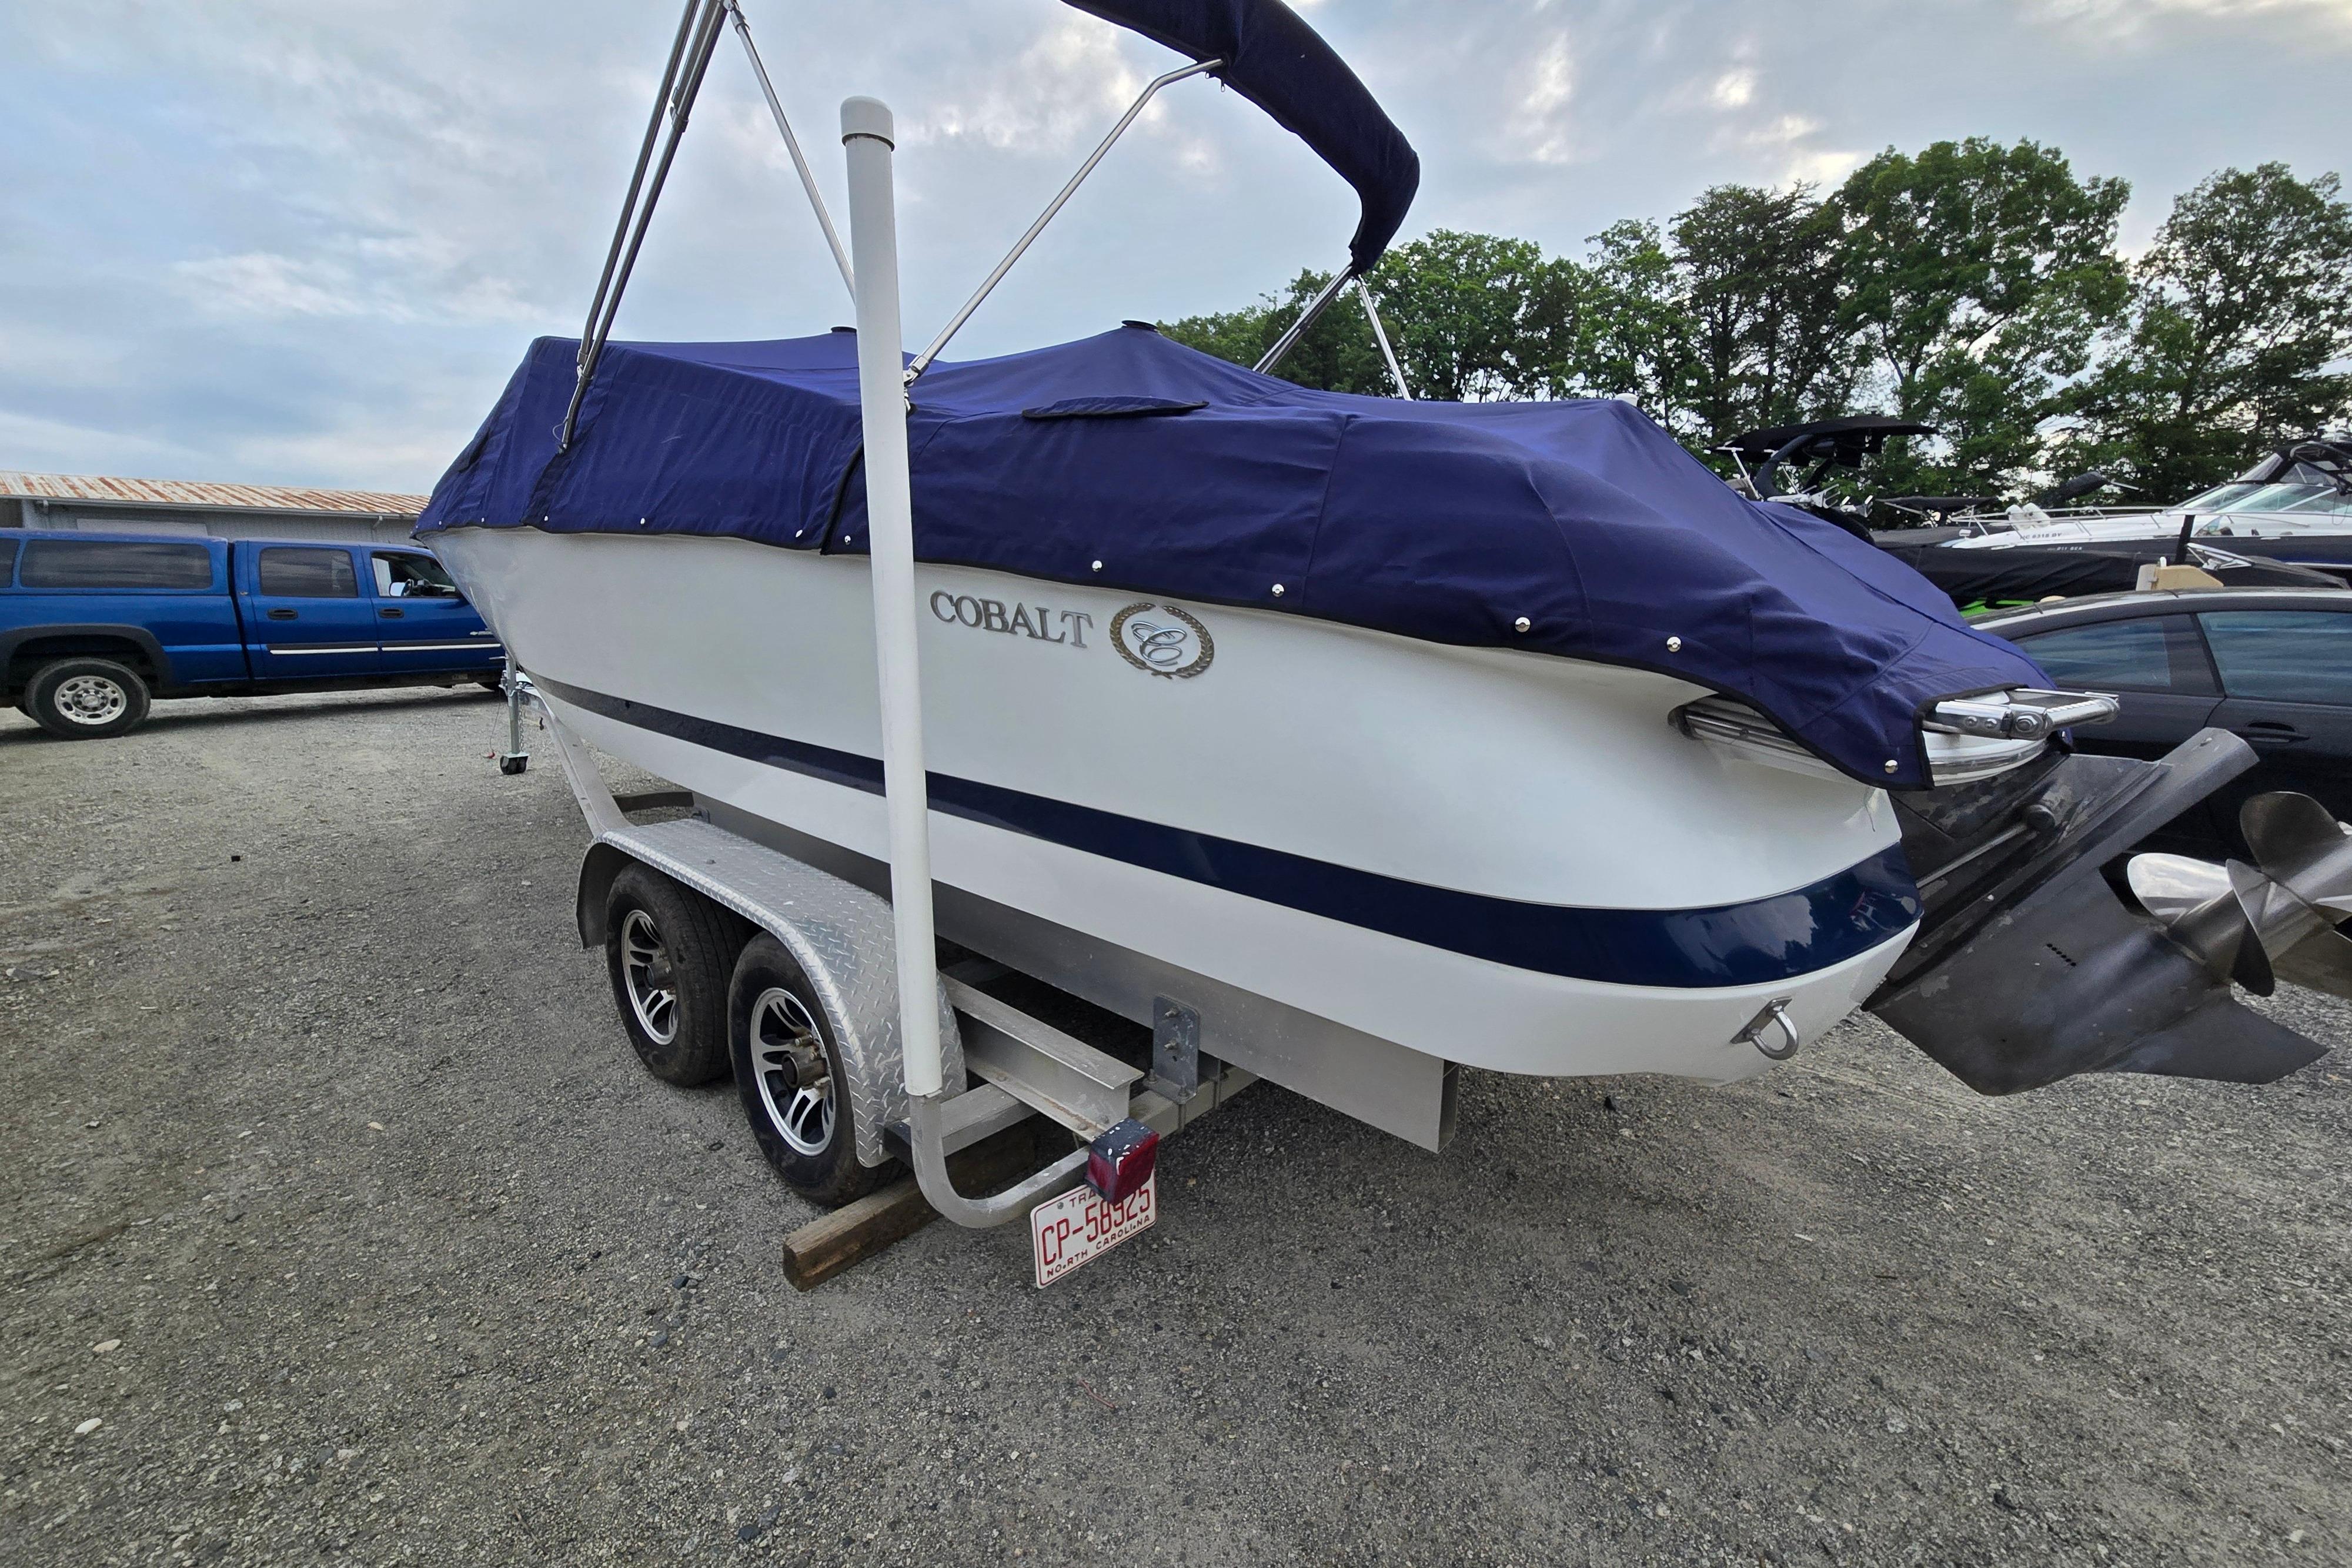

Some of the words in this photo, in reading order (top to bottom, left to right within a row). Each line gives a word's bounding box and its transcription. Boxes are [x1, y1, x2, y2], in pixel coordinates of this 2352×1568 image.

[930, 589, 1094, 649] COBALT
[1041, 1188, 1151, 1266] CP-58925
[1069, 1189, 1097, 1208] TRA
[1047, 1249, 1088, 1278] NORTH
[1095, 1214, 1150, 1250] CAROLINA
